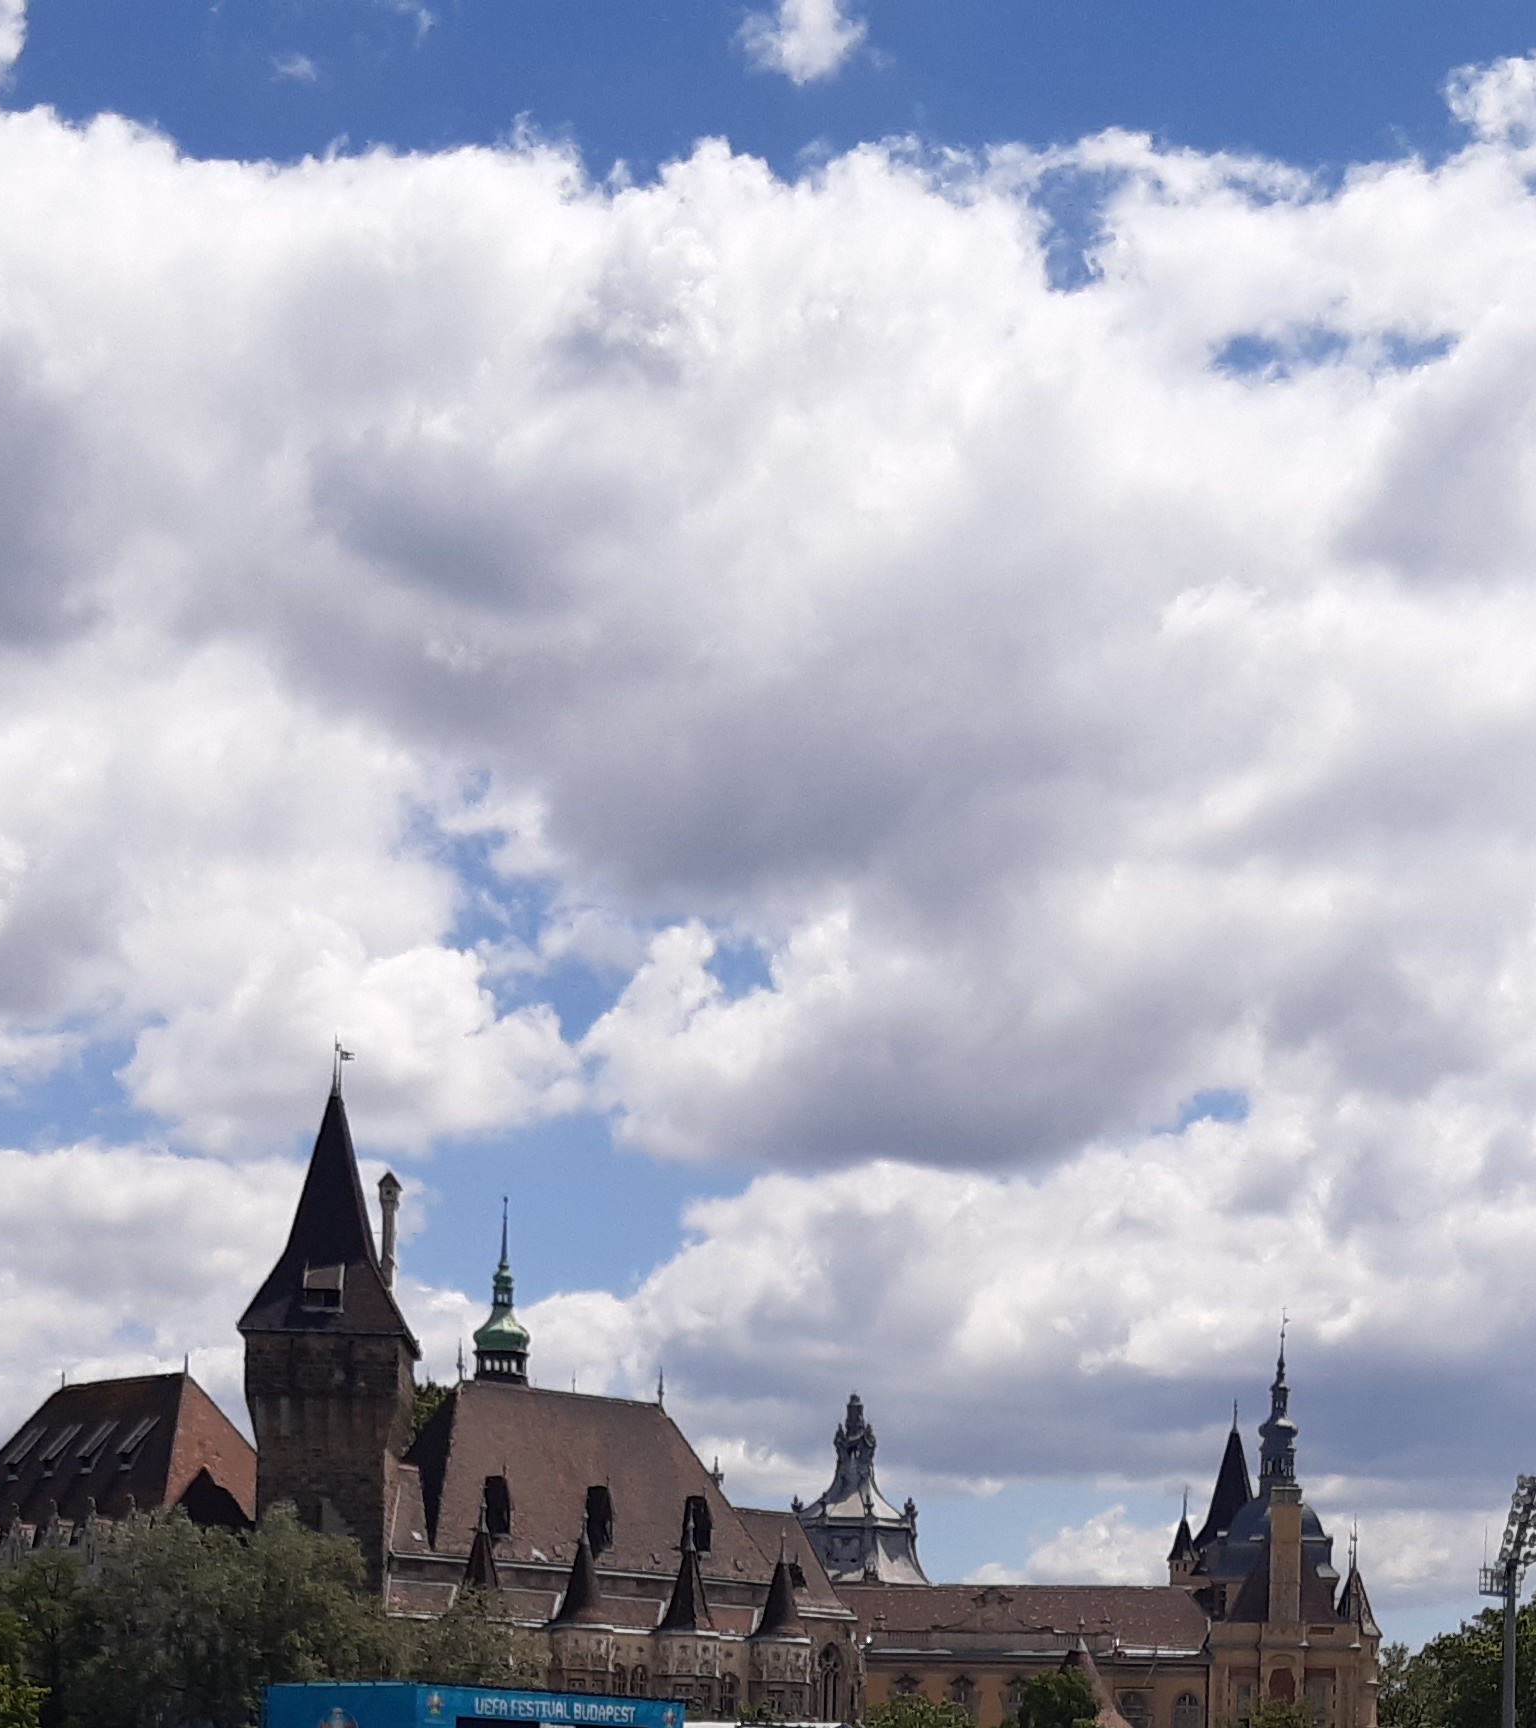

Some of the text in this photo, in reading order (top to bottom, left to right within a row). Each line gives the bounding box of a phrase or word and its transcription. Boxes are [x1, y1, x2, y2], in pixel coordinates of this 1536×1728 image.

[475, 1697, 636, 1723] UEFA FESTIVAL BUDAPEST
